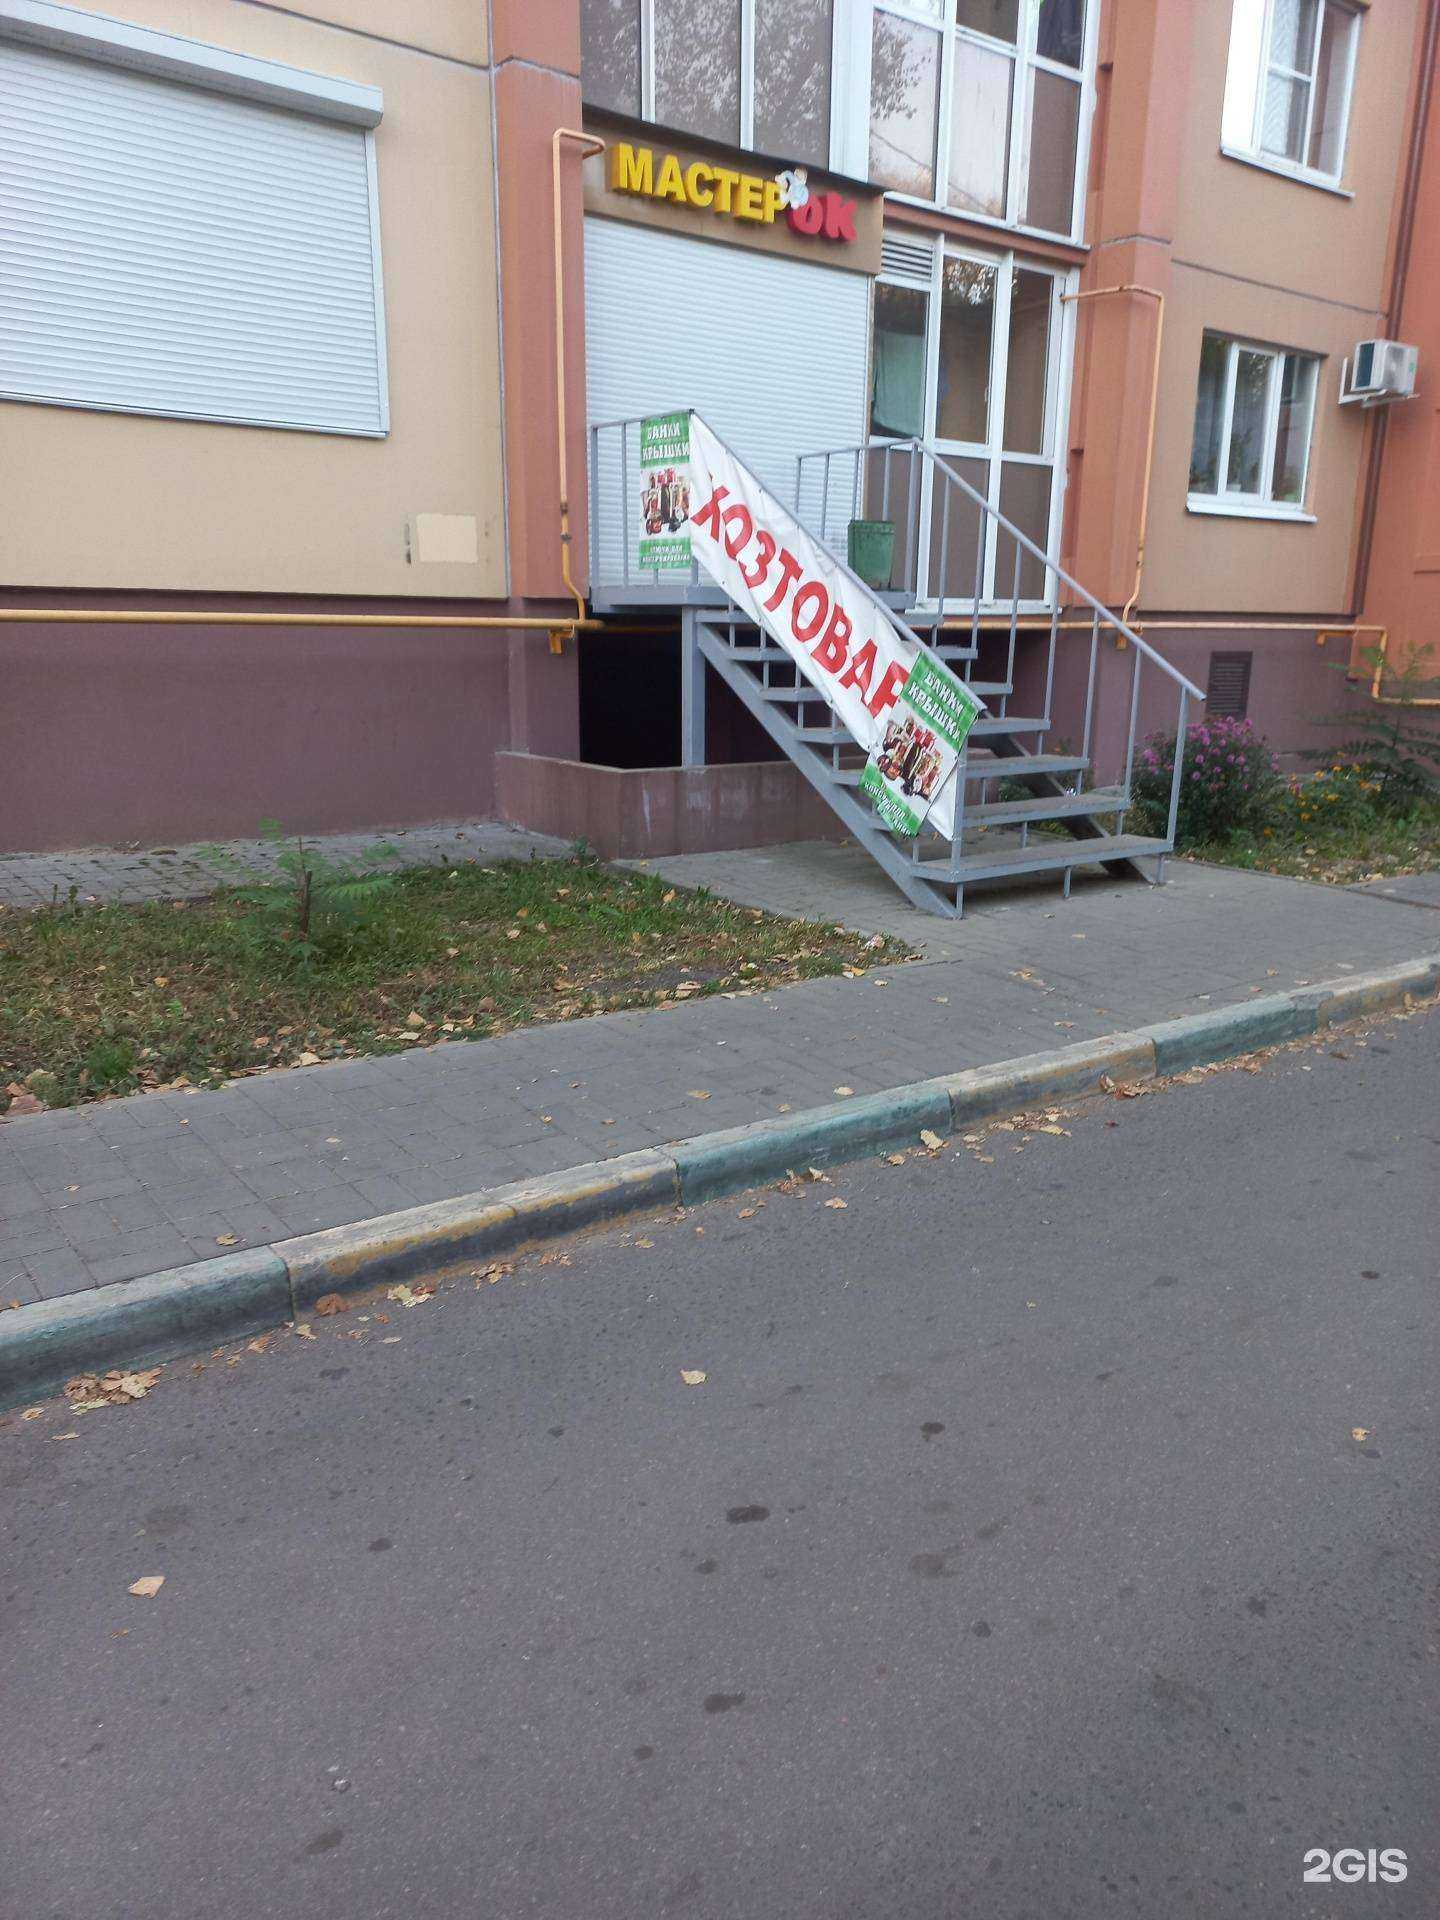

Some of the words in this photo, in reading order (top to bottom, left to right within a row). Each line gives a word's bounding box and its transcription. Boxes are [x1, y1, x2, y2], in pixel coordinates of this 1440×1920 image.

[647, 422, 681, 439] БАНКИ
[642, 441, 690, 461] КРЫШКИ
[924, 670, 964, 717] БАНКИ
[908, 681, 961, 742] КРЫШКИ
